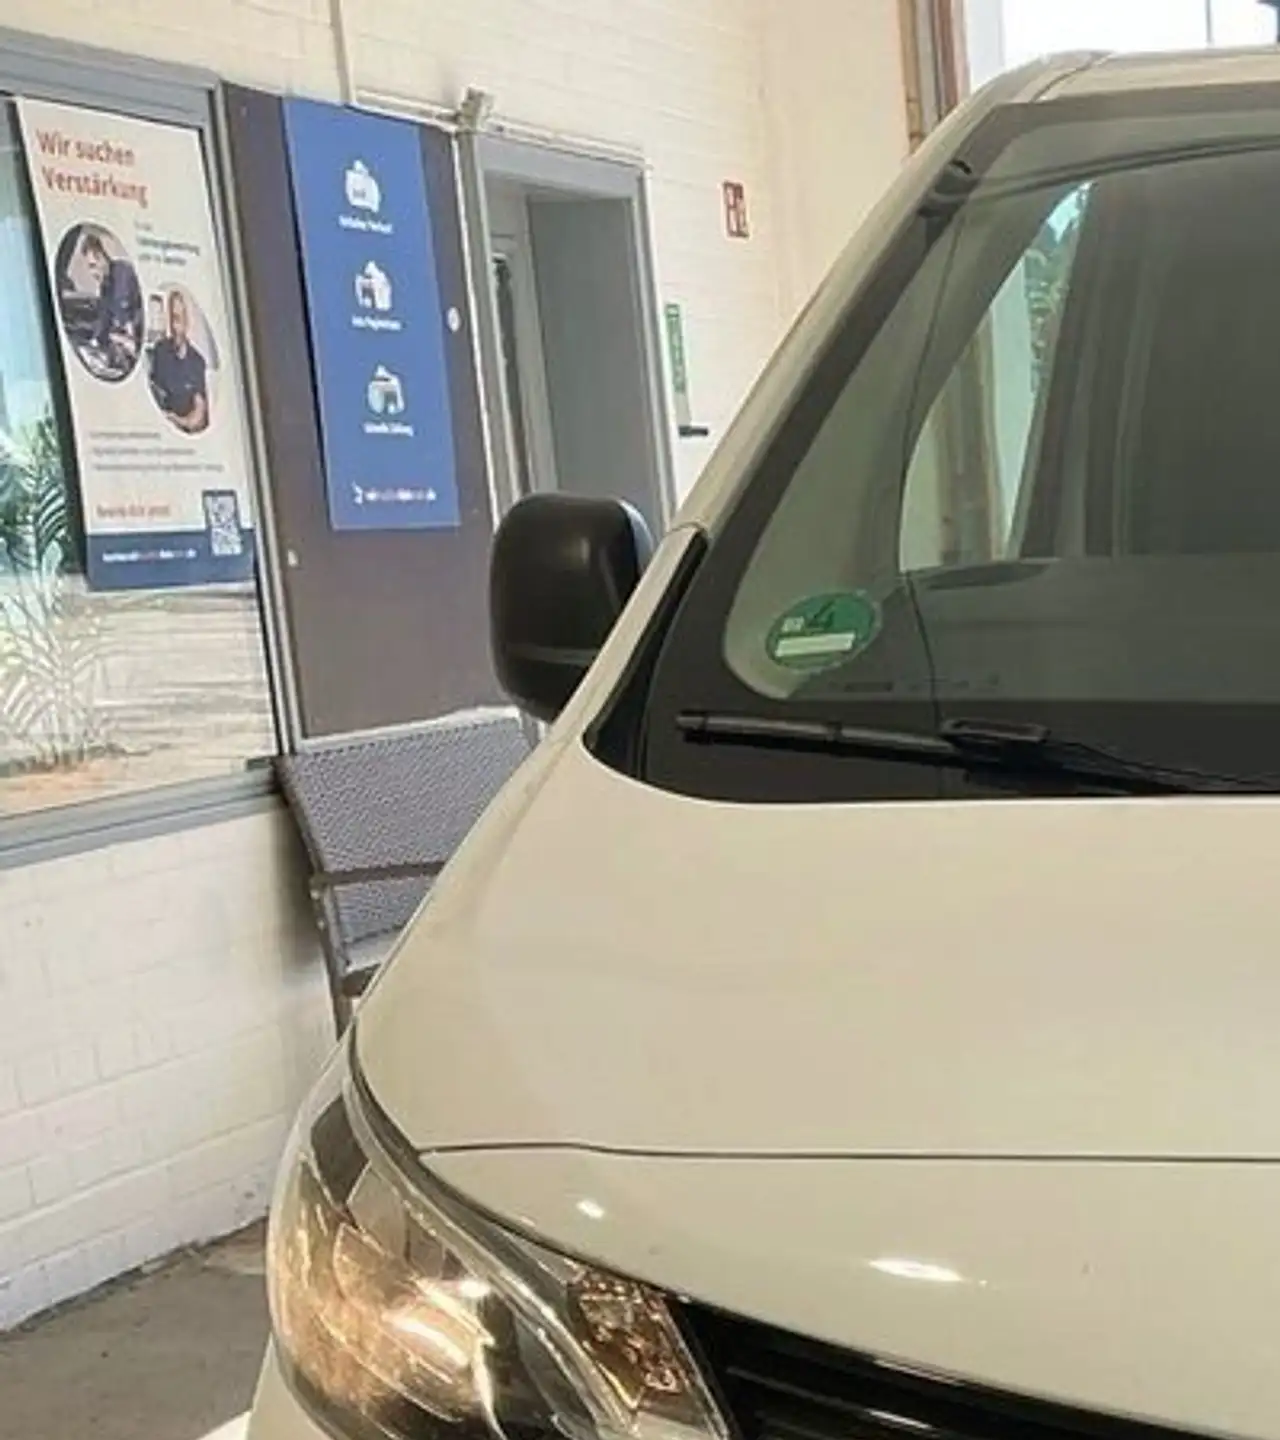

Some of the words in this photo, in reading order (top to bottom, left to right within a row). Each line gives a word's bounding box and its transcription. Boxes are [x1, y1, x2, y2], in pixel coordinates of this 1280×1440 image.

[35, 129, 70, 156] Wir
[75, 139, 135, 166] suchen
[41, 167, 148, 209] Verstärkung
